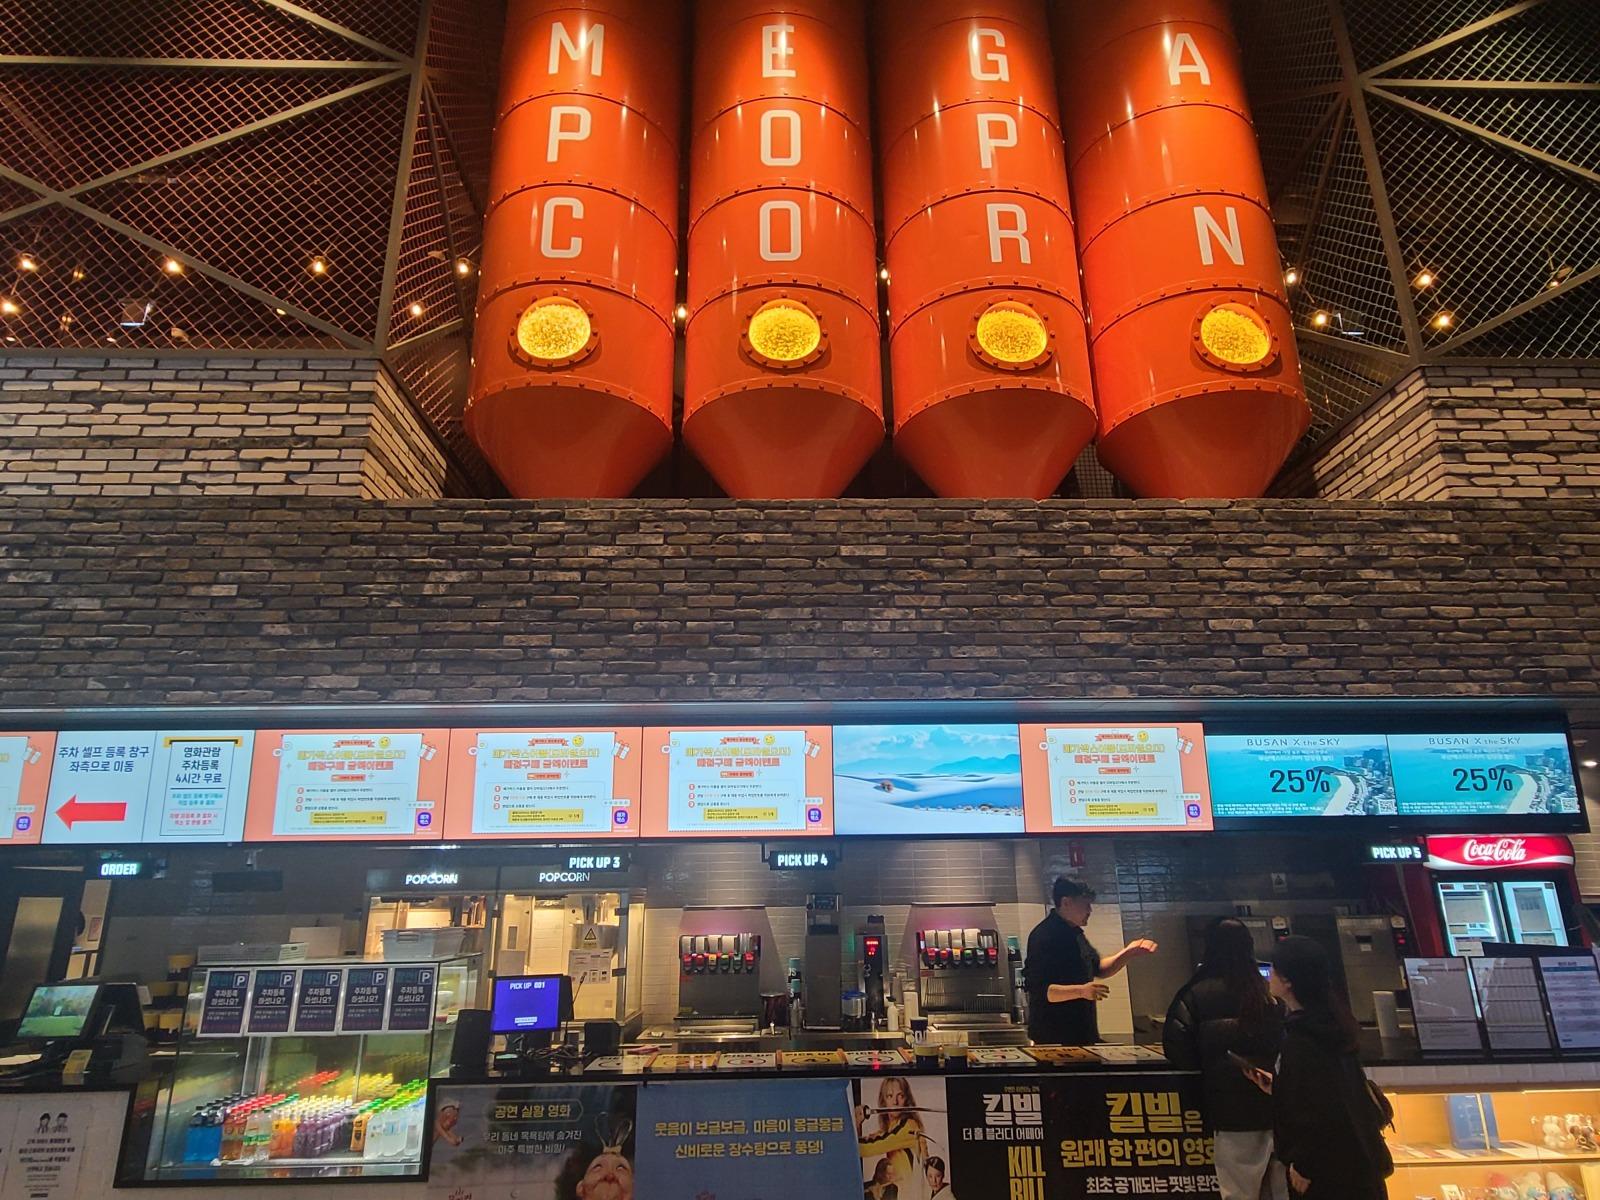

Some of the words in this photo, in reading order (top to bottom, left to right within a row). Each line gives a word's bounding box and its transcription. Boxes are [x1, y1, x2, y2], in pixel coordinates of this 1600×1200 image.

[1246, 738, 1288, 746] BUSAN
[1292, 738, 1300, 746] X
[1319, 738, 1340, 746] SKY
[1428, 737, 1470, 745] BUSAN
[58, 746, 79, 758] 주차
[82, 746, 103, 758] 셀프
[105, 746, 126, 758] 등록
[128, 746, 150, 758] 창구
[184, 746, 221, 758] 영화관람
[69, 760, 110, 772] 좌측으로
[114, 760, 134, 772] 이동
[182, 760, 220, 771] 주차등록
[176, 773, 201, 784] 4시간
[203, 773, 222, 784] 무료
[1269, 769, 1331, 793] 25%
[1452, 768, 1514, 792] 25%
[1371, 846, 1398, 859] PICK
[1398, 846, 1412, 859] UP
[1412, 846, 1422, 858] 5
[1463, 838, 1526, 862] Coca-Cola
[568, 856, 594, 869] PICK
[596, 856, 611, 868] UP
[612, 856, 620, 868] 3
[777, 854, 802, 866] PICK
[804, 854, 818, 866] UP
[820, 854, 828, 866] 4
[101, 863, 137, 876] ORDER
[405, 873, 458, 885] POPCORN
[539, 872, 590, 883] POPCORN
[236, 976, 246, 986] P
[284, 974, 292, 985] P
[329, 974, 338, 984] P
[375, 974, 384, 984] P
[421, 972, 430, 982] P
[510, 982, 522, 990] PICK
[495, 1104, 518, 1119] 공연
[522, 1104, 544, 1118] 실황
[548, 1104, 571, 1118] 영화
[982, 1094, 1042, 1126] 킬빌
[654, 1122, 692, 1137] 웃음이
[696, 1120, 749, 1136] 보글보글,
[753, 1118, 790, 1134] 마음이
[794, 1118, 844, 1132] 몽글몽글
[962, 1128, 972, 1140] 더
[974, 1128, 984, 1140] 홀
[986, 1127, 1014, 1140] 블러디
[1016, 1127, 1044, 1140] 어페어
[502, 1131, 519, 1142] 동네
[675, 1142, 725, 1159] 신비로운
[728, 1142, 792, 1157] 장수탕으로
[795, 1140, 824, 1154] 풍덩!
[1060, 1138, 1106, 1168] 원래
[1108, 1138, 1132, 1166] 한
[1134, 1138, 1181, 1167] 편의
[1008, 1146, 1046, 1178] KILL
[1086, 1176, 1114, 1194] 최초
[1114, 1176, 1168, 1194] 공개되는
[1168, 1176, 1196, 1193] 핏빛
